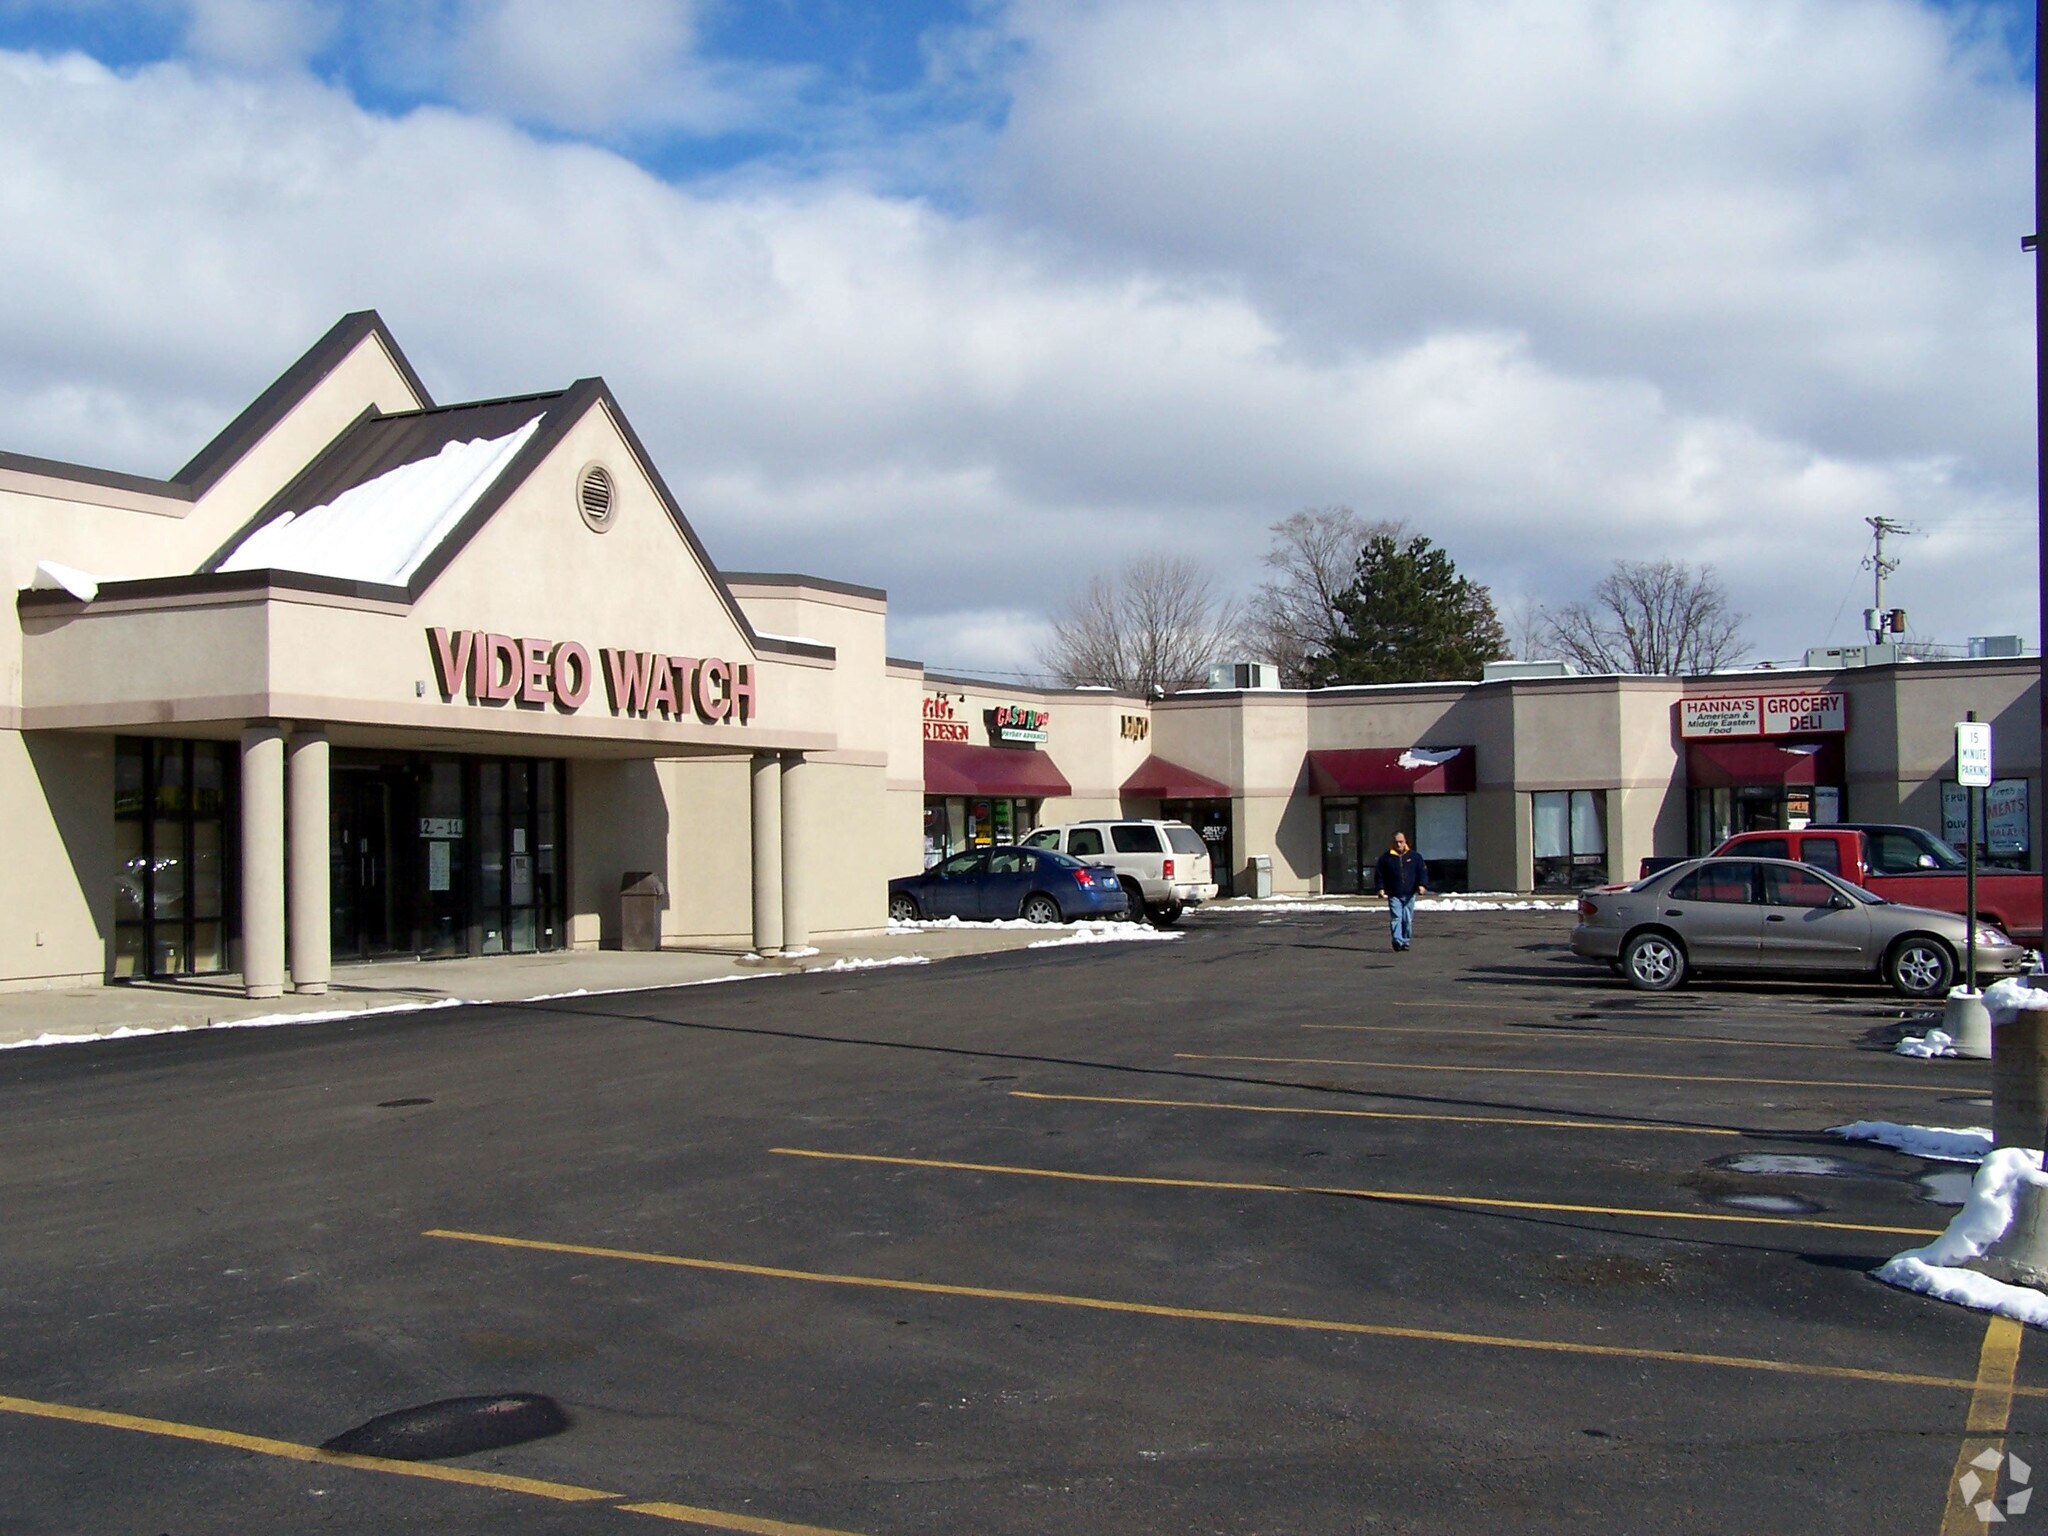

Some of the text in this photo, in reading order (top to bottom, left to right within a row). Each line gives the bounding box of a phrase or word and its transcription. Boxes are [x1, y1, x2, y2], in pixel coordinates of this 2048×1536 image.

[427, 627, 755, 726] VIDEO WATCH
[1687, 700, 1755, 713] HANNA'S
[1767, 697, 1839, 713] GROCERY
[1687, 719, 1756, 728] Middle Eastern
[1790, 715, 1822, 731] DELI
[933, 723, 969, 740] DESIGN
[1708, 727, 1732, 735] Food
[1970, 732, 1979, 744] 15
[1962, 749, 1987, 760] MINUTE
[1961, 765, 1988, 777] PARKING
[1945, 794, 1967, 802] FRUI
[1987, 799, 2025, 818] MEATS
[1946, 820, 1967, 828] OLIV
